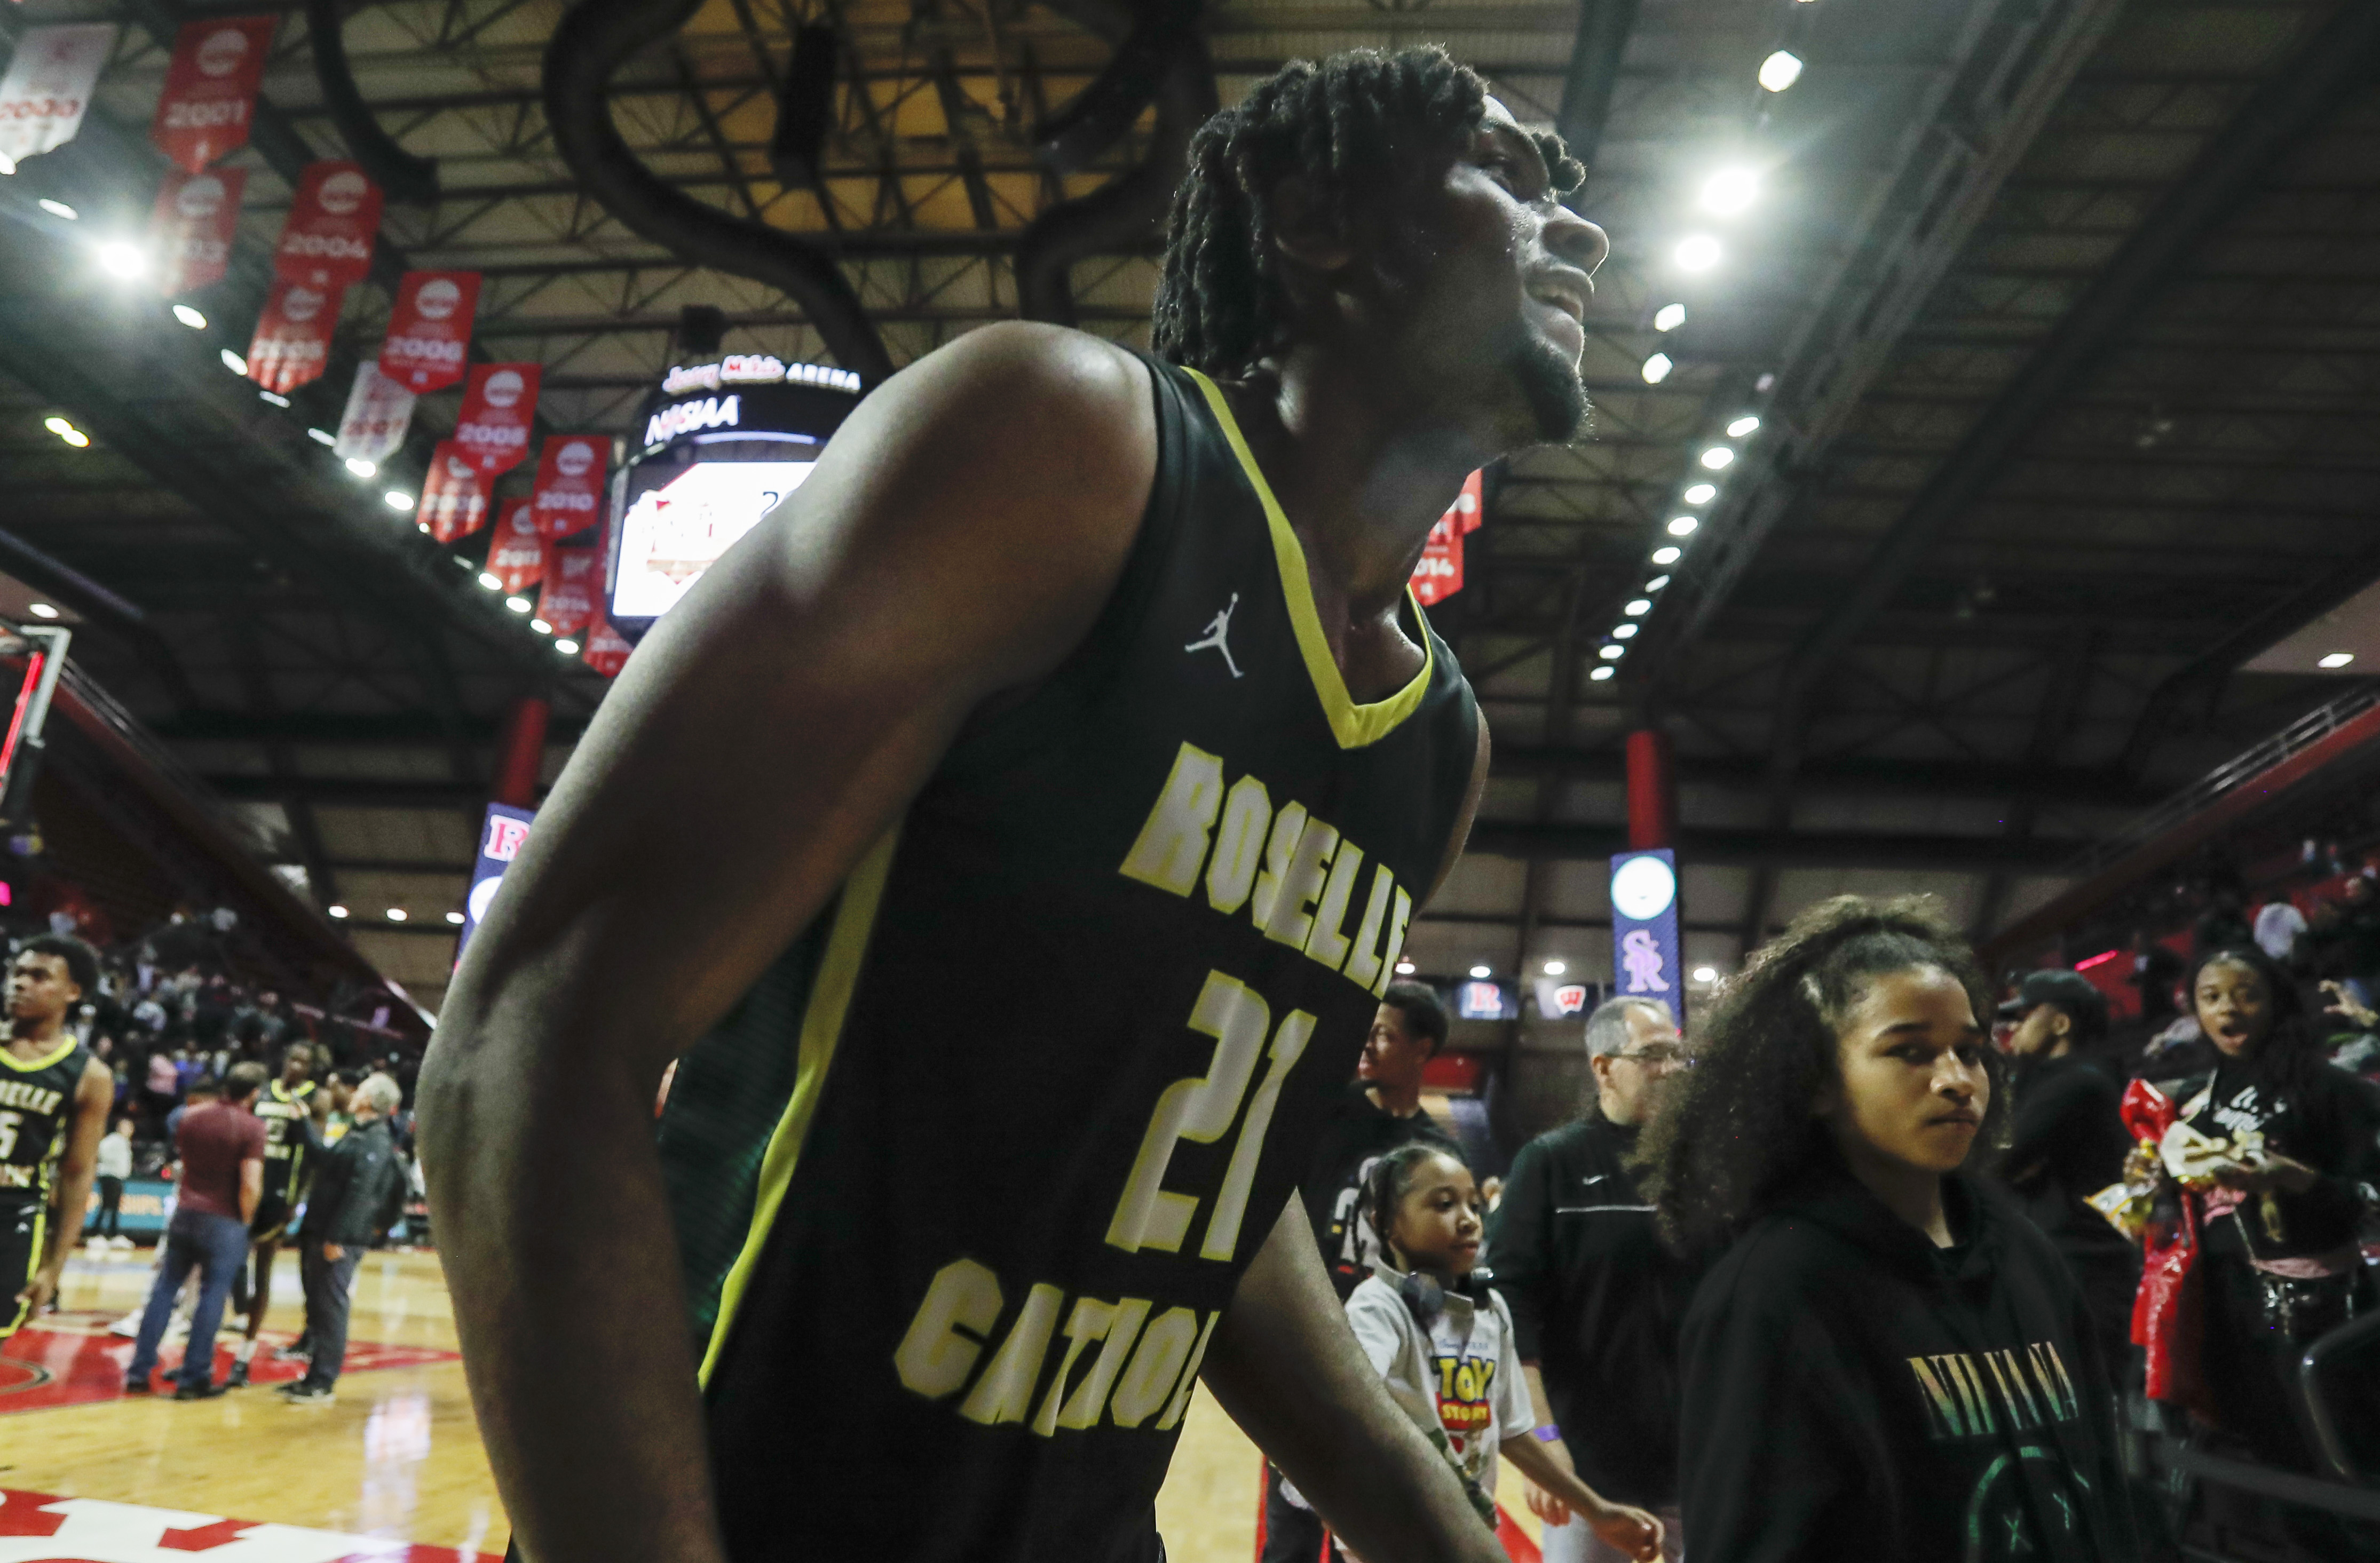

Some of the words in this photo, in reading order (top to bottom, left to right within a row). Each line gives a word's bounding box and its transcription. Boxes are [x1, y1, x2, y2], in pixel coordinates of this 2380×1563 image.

[786, 362, 861, 391] ARENA
[1105, 969, 1317, 1262] 21
[1436, 1355, 1497, 1405] TOY
